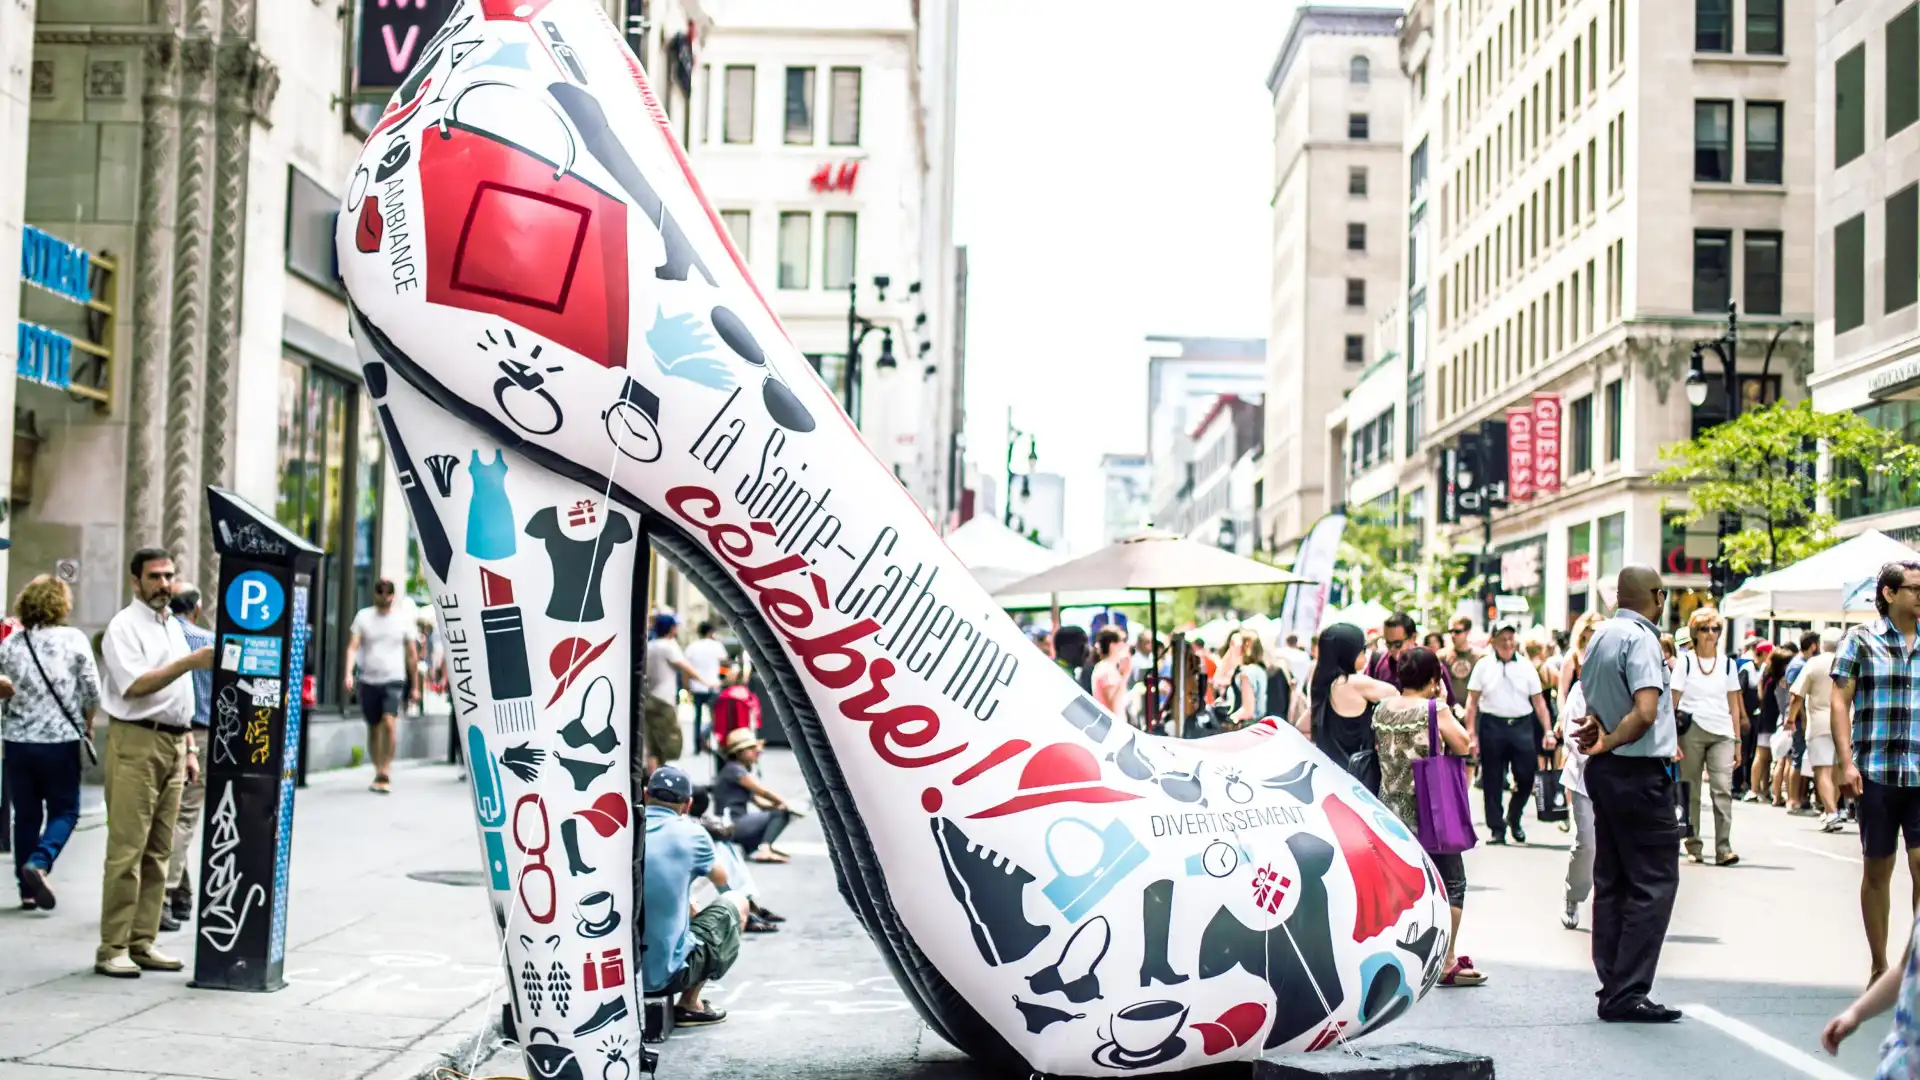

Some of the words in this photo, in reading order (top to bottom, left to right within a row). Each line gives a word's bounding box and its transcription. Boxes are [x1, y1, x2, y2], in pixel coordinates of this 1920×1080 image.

[384, 178, 418, 295] AMBIANCE
[1508, 413, 1533, 499] GUESS
[1535, 399, 1559, 489] GUESS
[688, 386, 746, 474] La
[734, 427, 1019, 722] Sainte-Catherine
[435, 593, 479, 716] VARIÉTÉ
[1150, 805, 1306, 838] DIVERTISSEMENT
